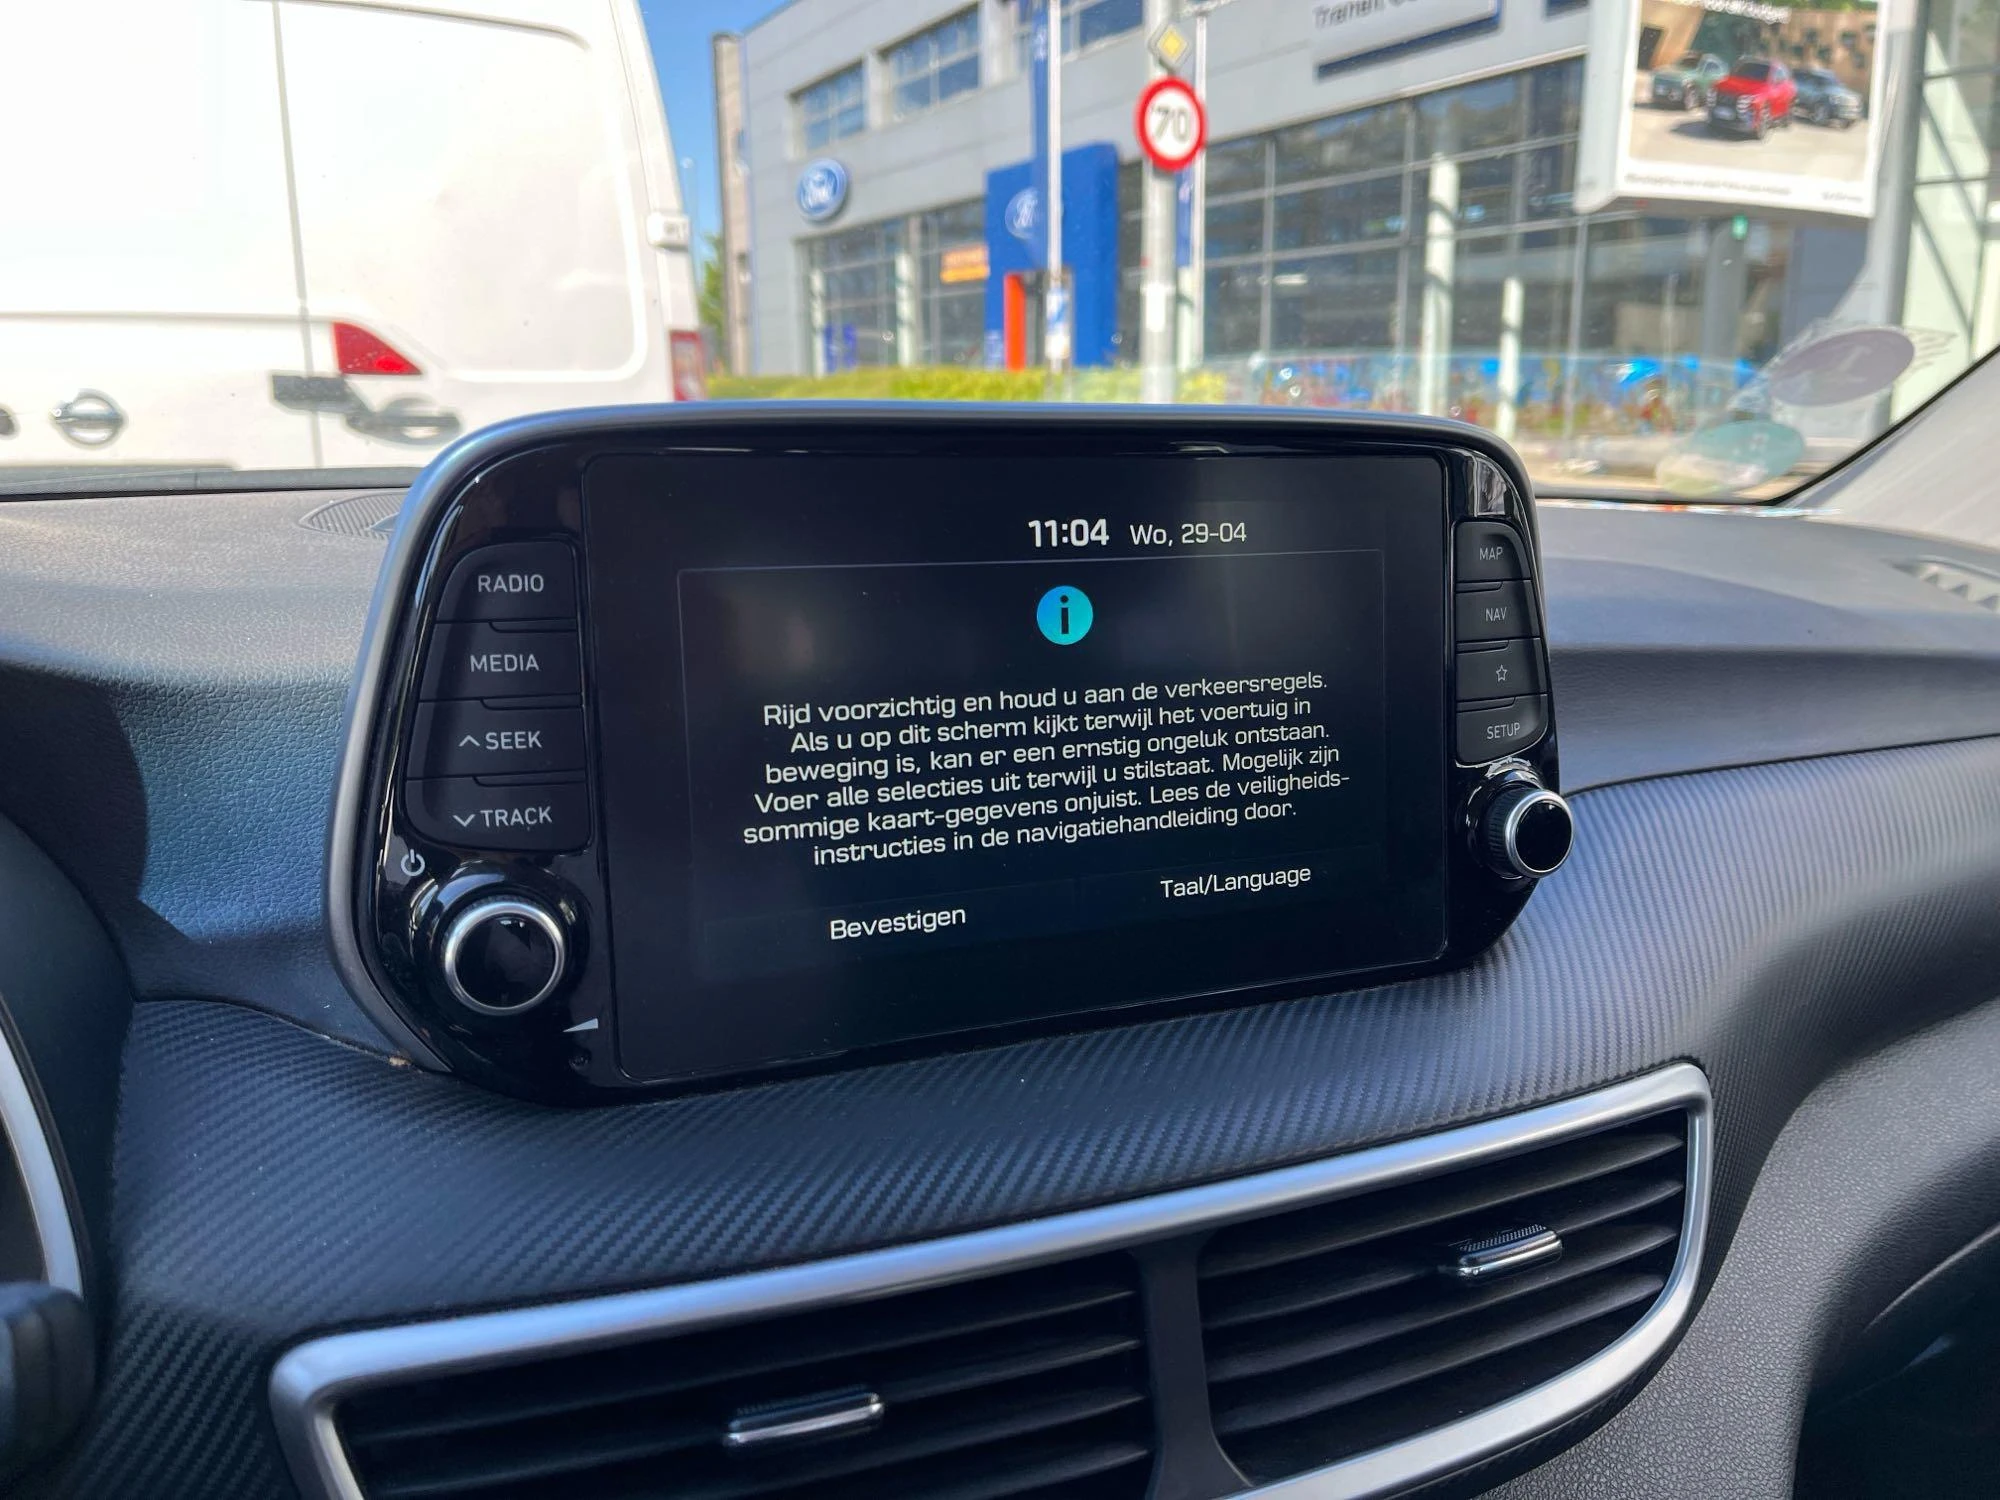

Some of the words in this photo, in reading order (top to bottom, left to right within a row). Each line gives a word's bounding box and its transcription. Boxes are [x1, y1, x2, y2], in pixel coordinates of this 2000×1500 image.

[1153, 105, 1190, 142] 70
[1028, 518, 1110, 548] 11:04
[1129, 524, 1173, 547] Wo,
[1181, 522, 1247, 544] 29-04
[1479, 546, 1503, 561] MAP
[478, 574, 544, 593] RADIO
[1485, 606, 1508, 622] NAV
[470, 653, 539, 673] MEDIA
[763, 702, 811, 730] Rijd
[817, 694, 956, 722] voorzichtig
[963, 695, 992, 713] en
[999, 687, 1057, 710] houd
[1063, 690, 1077, 706] u
[1084, 687, 1125, 704] aan
[1131, 682, 1158, 701] de
[1164, 671, 1327, 699] verkeersregels.
[485, 730, 542, 750] SEEK
[790, 731, 829, 753] Als
[837, 733, 852, 750] u
[860, 730, 892, 752] op
[898, 724, 932, 745] dit
[937, 720, 1027, 742] scherm
[1033, 714, 1079, 738] kijkt
[1083, 707, 1154, 731] terwijl
[1159, 706, 1195, 725] het
[1200, 698, 1288, 722] voertuig
[1294, 697, 1311, 715] in
[1486, 722, 1521, 740] SETUP
[765, 756, 889, 784] beweging
[896, 753, 921, 775] is,
[930, 750, 973, 771] kan
[979, 749, 1007, 766] er
[1013, 745, 1056, 763] een
[1062, 735, 1141, 759] ernstig
[1147, 728, 1229, 755] ongeluk
[1234, 724, 1329, 745] ontstaan.
[754, 792, 820, 814] Voer
[826, 785, 870, 808] alle
[877, 776, 984, 803] selecties
[990, 772, 1022, 793] uit
[1026, 764, 1098, 789] terwijl
[1103, 767, 1117, 782] u
[1123, 757, 1215, 781] stilstaat.
[1222, 747, 1304, 773] Mogelijk
[1309, 745, 1339, 767] zijn
[479, 806, 553, 828] TRACK
[743, 816, 860, 844] sommige
[867, 799, 1058, 832] kaart-gegevens
[1064, 789, 1142, 815] onjuist.
[1150, 785, 1199, 804] Lees
[1205, 780, 1231, 799] de
[1236, 770, 1350, 796] veiligheids-
[814, 835, 946, 866] instructies
[953, 831, 973, 851] in
[981, 827, 1010, 848] de
[1016, 806, 1238, 844] navigatiehandleiding
[1244, 802, 1298, 821] door.
[1159, 868, 1311, 898] Taal/Language
[830, 908, 966, 940] Bevestigen
